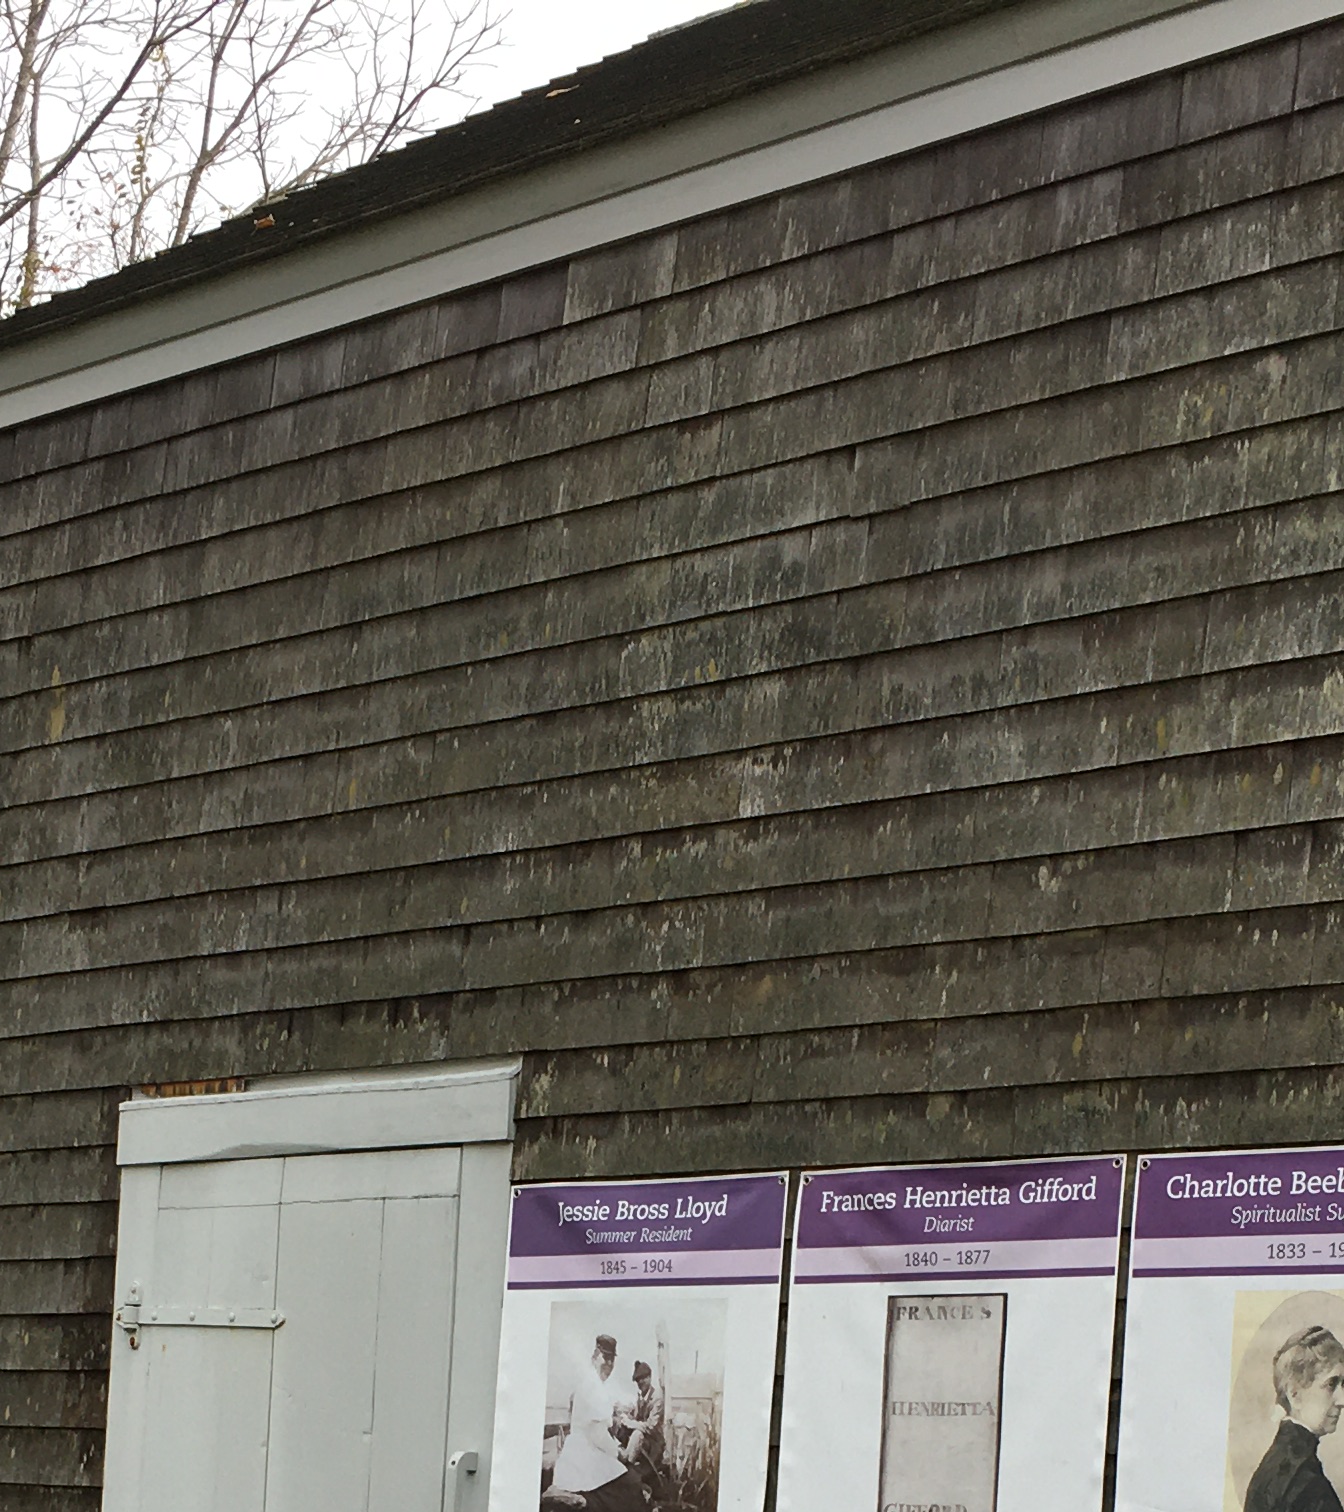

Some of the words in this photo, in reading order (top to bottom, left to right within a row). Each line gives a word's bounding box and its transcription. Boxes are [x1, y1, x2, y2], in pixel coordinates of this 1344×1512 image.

[820, 1190, 896, 1212] Frances
[903, 1182, 1010, 1208] Henrietta
[1018, 1175, 1096, 1203] Gifford
[1166, 1171, 1281, 1198] Charlotte
[558, 1199, 609, 1226] Jessie
[614, 1200, 669, 1220] Bross
[674, 1193, 727, 1223] Lloyd
[1230, 1202, 1321, 1228] Spiritualist
[923, 1216, 974, 1232] Diarist
[585, 1228, 637, 1244] Summer
[639, 1225, 692, 1242] Resident
[904, 1250, 937, 1267] 1840
[956, 1249, 990, 1265] 1877
[1267, 1242, 1305, 1259] 1833
[600, 1259, 626, 1274] 1845
[642, 1258, 672, 1273] 1904
[891, 1401, 996, 1417] HENRIETTA
